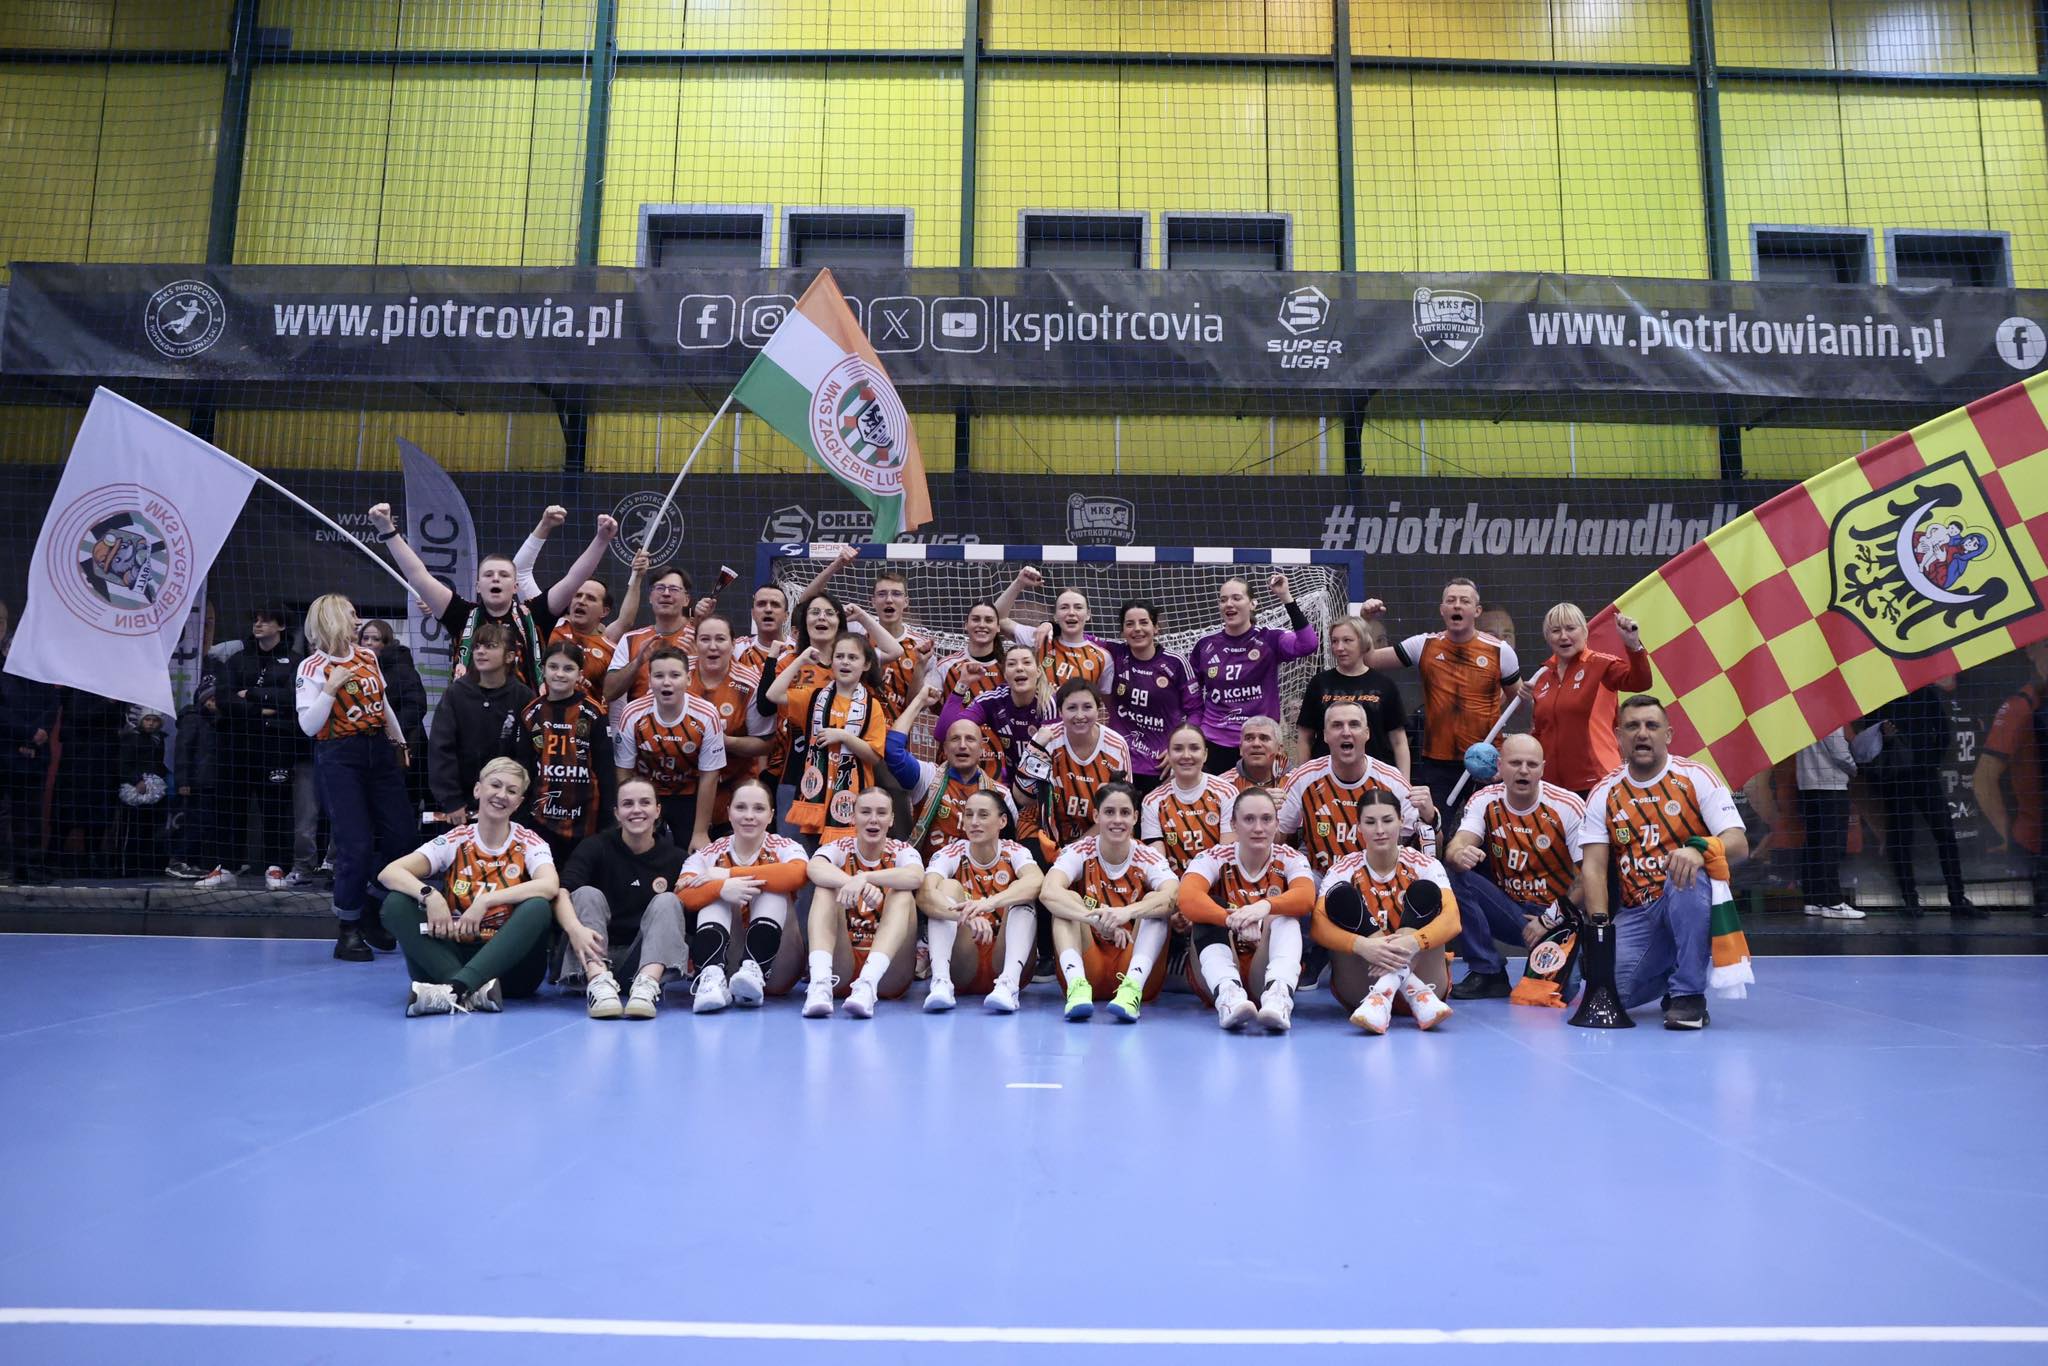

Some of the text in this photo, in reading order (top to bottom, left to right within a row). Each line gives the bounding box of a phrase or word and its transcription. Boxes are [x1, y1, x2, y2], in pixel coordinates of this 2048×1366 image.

[156, 284, 218, 307] MKS PIOTRCOVIA
[1438, 300, 1459, 310] MKS
[273, 296, 625, 346] www.piotrcovia.pl
[1002, 300, 1224, 351] kspiotrcovia
[1418, 323, 1480, 334] PIOTRKOWIANIN
[1266, 339, 1343, 354] SUPER
[1527, 310, 1946, 365] www.piotrkowianin.pl
[1280, 355, 1331, 370] LIGA
[819, 380, 843, 416] MKS
[818, 418, 874, 483] ZAGŁĘBIE
[634, 495, 676, 518] PIOTRCVIA
[1091, 506, 1112, 516] MKS
[337, 512, 400, 527] WYJE
[1055, 661, 1075, 680] 81
[1225, 664, 1243, 681] 27
[1130, 687, 1149, 708] 99
[1223, 684, 1263, 699] KGHM
[547, 734, 567, 756] 21
[1956, 730, 1976, 762] 32
[543, 764, 590, 778] KGHM
[1066, 795, 1090, 818] 83
[1182, 829, 1205, 851] 22
[1336, 822, 1358, 845] 84
[1640, 823, 1660, 847] 76
[1507, 848, 1529, 872] 87
[1504, 877, 1548, 891] KGHM
